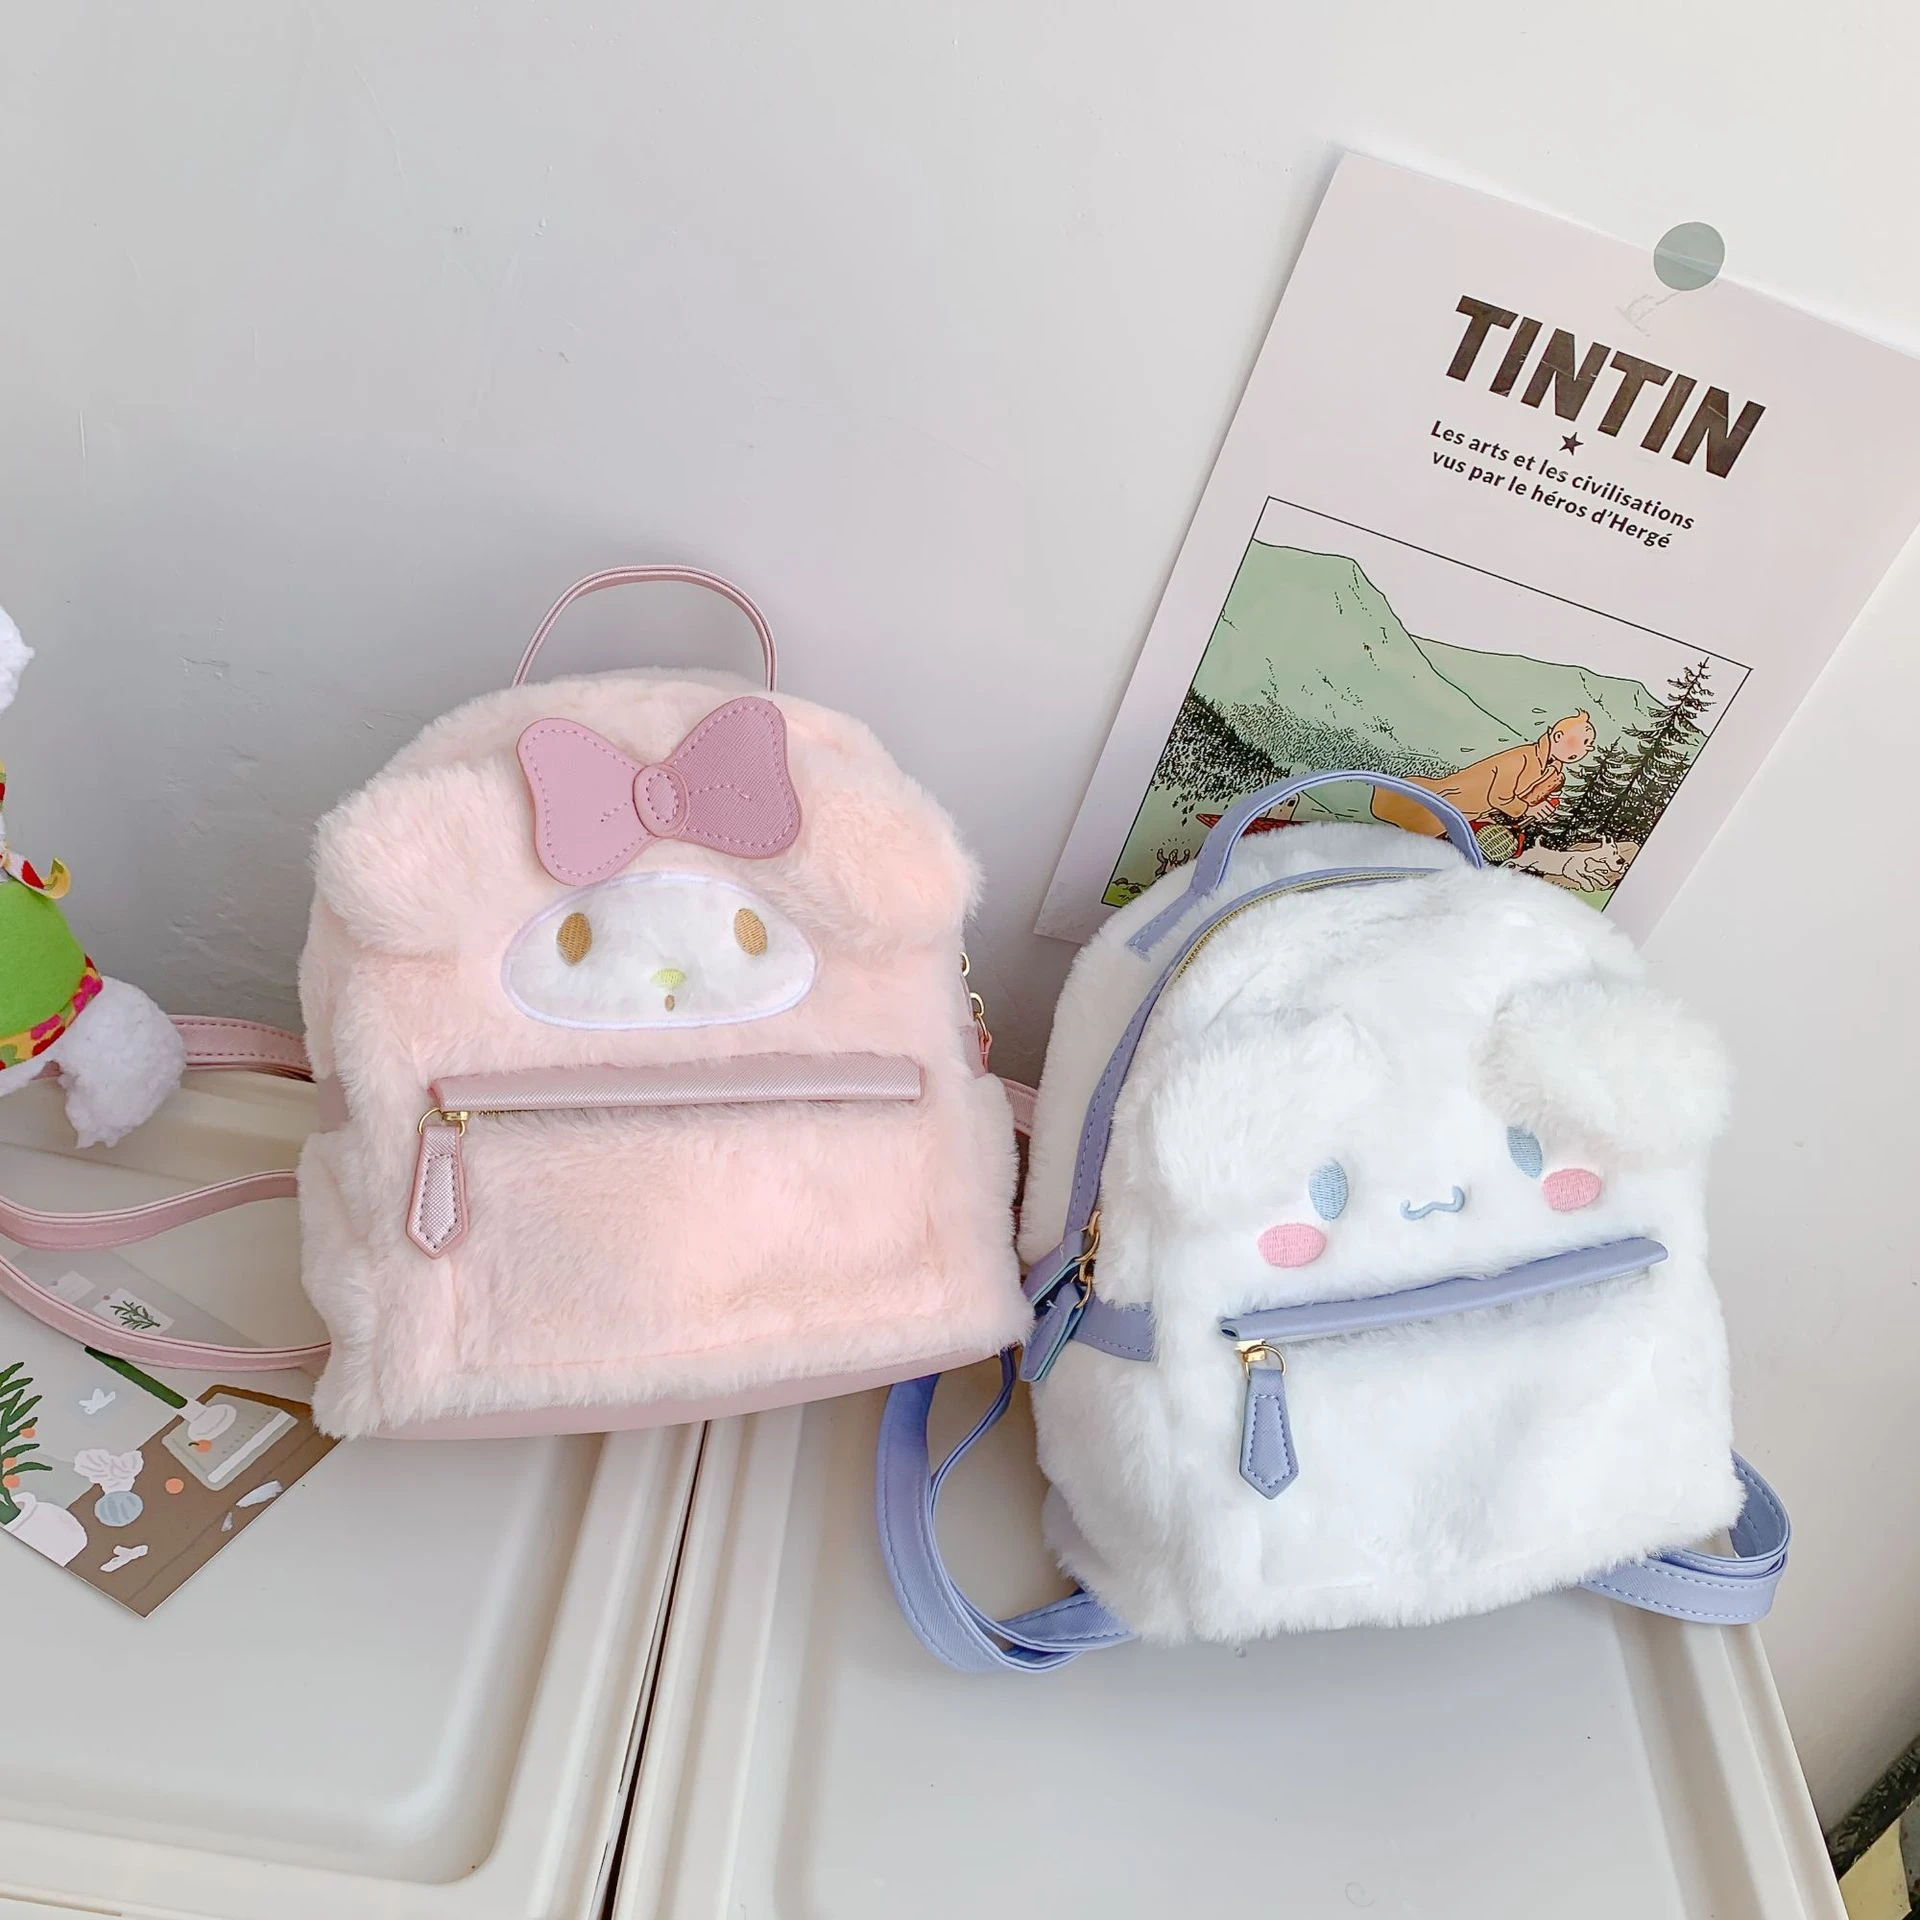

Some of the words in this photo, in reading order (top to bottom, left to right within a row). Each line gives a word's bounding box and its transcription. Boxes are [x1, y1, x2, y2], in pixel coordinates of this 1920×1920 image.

[1446, 295, 1766, 479] TINTIN
[1430, 419, 1465, 446] Les
[1468, 438, 1510, 462] arts
[1513, 454, 1536, 472] et
[1538, 458, 1569, 483] les
[1571, 475, 1695, 530] civilisations
[1433, 451, 1467, 474] vus
[1467, 465, 1506, 487] par
[1507, 475, 1528, 496] le
[1530, 484, 1588, 518] héros
[1590, 508, 1673, 549] d’Hergé
